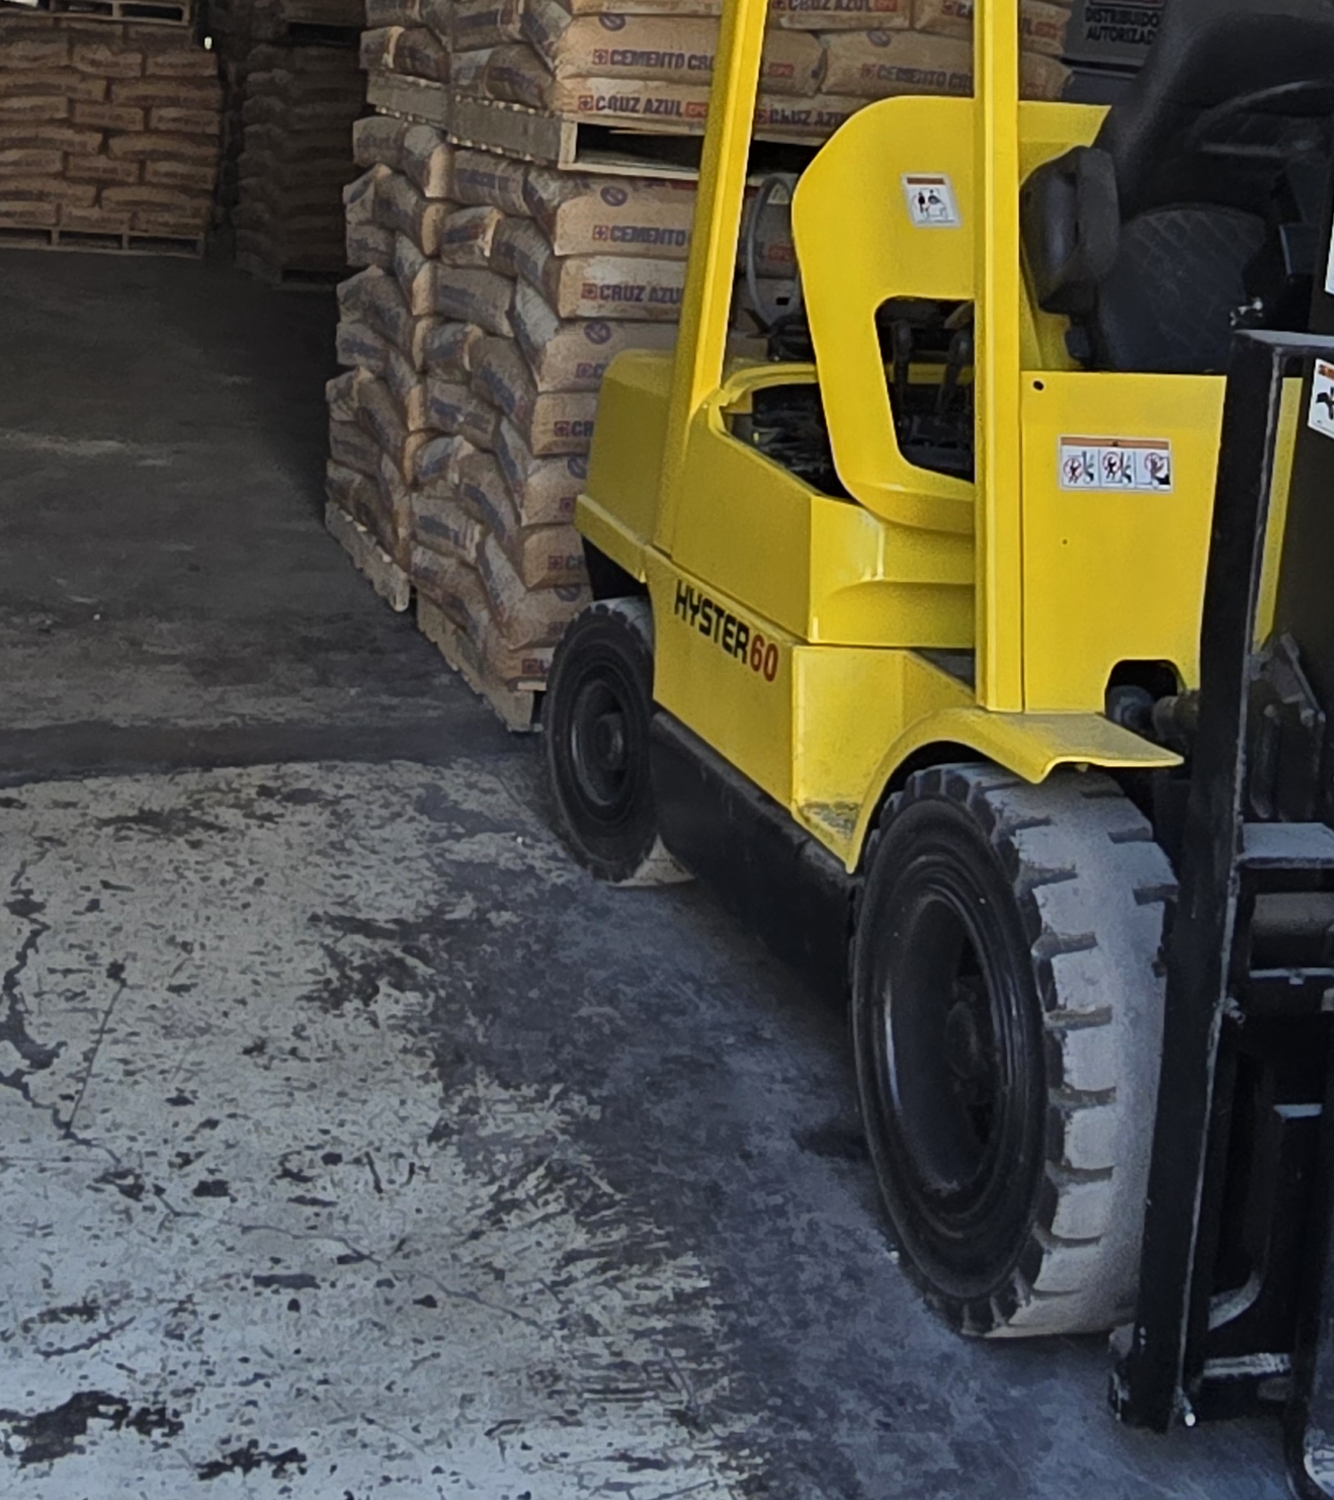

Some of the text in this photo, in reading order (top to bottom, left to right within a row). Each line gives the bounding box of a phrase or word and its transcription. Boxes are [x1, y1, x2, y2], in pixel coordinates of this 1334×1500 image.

[1087, 25, 1156, 45] AUTORIZAD
[610, 49, 685, 69] CEMENTO
[877, 64, 947, 87] CEMENTO
[595, 95, 641, 114] CRUZ
[643, 98, 683, 117] AZUL
[610, 225, 686, 246] CEMENTO
[599, 284, 682, 304] CRUZ AZU
[571, 420, 594, 438] CR
[674, 578, 778, 682] HYSTER 60
